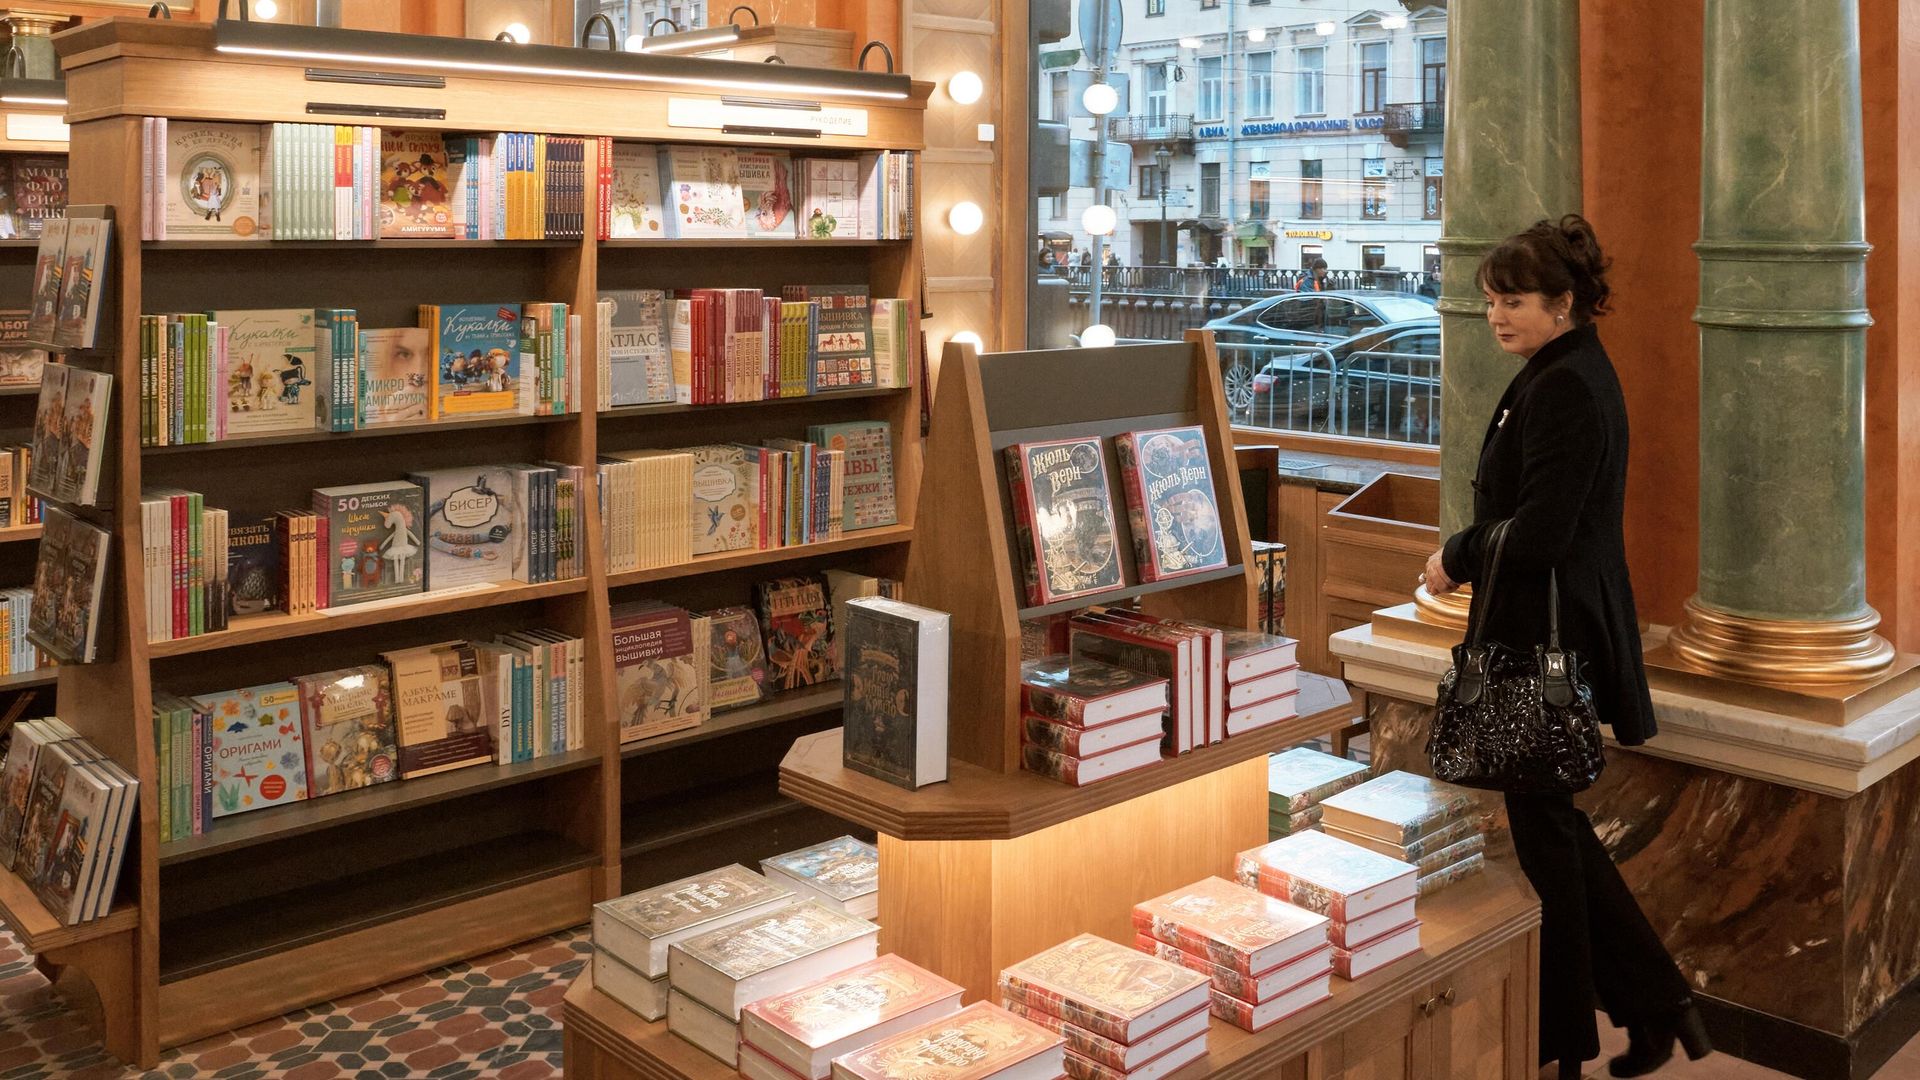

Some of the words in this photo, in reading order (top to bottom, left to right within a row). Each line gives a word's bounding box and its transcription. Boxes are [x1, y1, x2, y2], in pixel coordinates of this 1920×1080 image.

[810, 115, 852, 126] РУКОДЕЛИЕ
[1354, 117, 1384, 129] КАСС
[25, 167, 70, 179] МАГИ
[739, 169, 771, 179] ЫШИВКА
[818, 312, 863, 321] ЫШИВКА
[366, 378, 405, 392] МИКРО
[366, 393, 425, 407] АМИГУРУМИ
[1049, 464, 1082, 495] Верн
[1179, 465, 1207, 488] Верн
[843, 482, 880, 497] ТЕЖКИ
[338, 497, 360, 512] 50
[361, 494, 391, 503] ДЕТСКИХ
[361, 501, 388, 509] УЛЫБОК
[449, 497, 493, 512] БИСЕР
[228, 524, 270, 536] вязать
[228, 534, 270, 548] акона
[614, 630, 662, 646] Большая
[616, 647, 664, 663] вышивки
[402, 685, 439, 697] АЗБУКА
[403, 690, 457, 707] МАКРАМЕ
[502, 708, 510, 728] DIY
[219, 739, 282, 759] ОРИГАМИ
[204, 746, 213, 794] ОРИГАМИ
